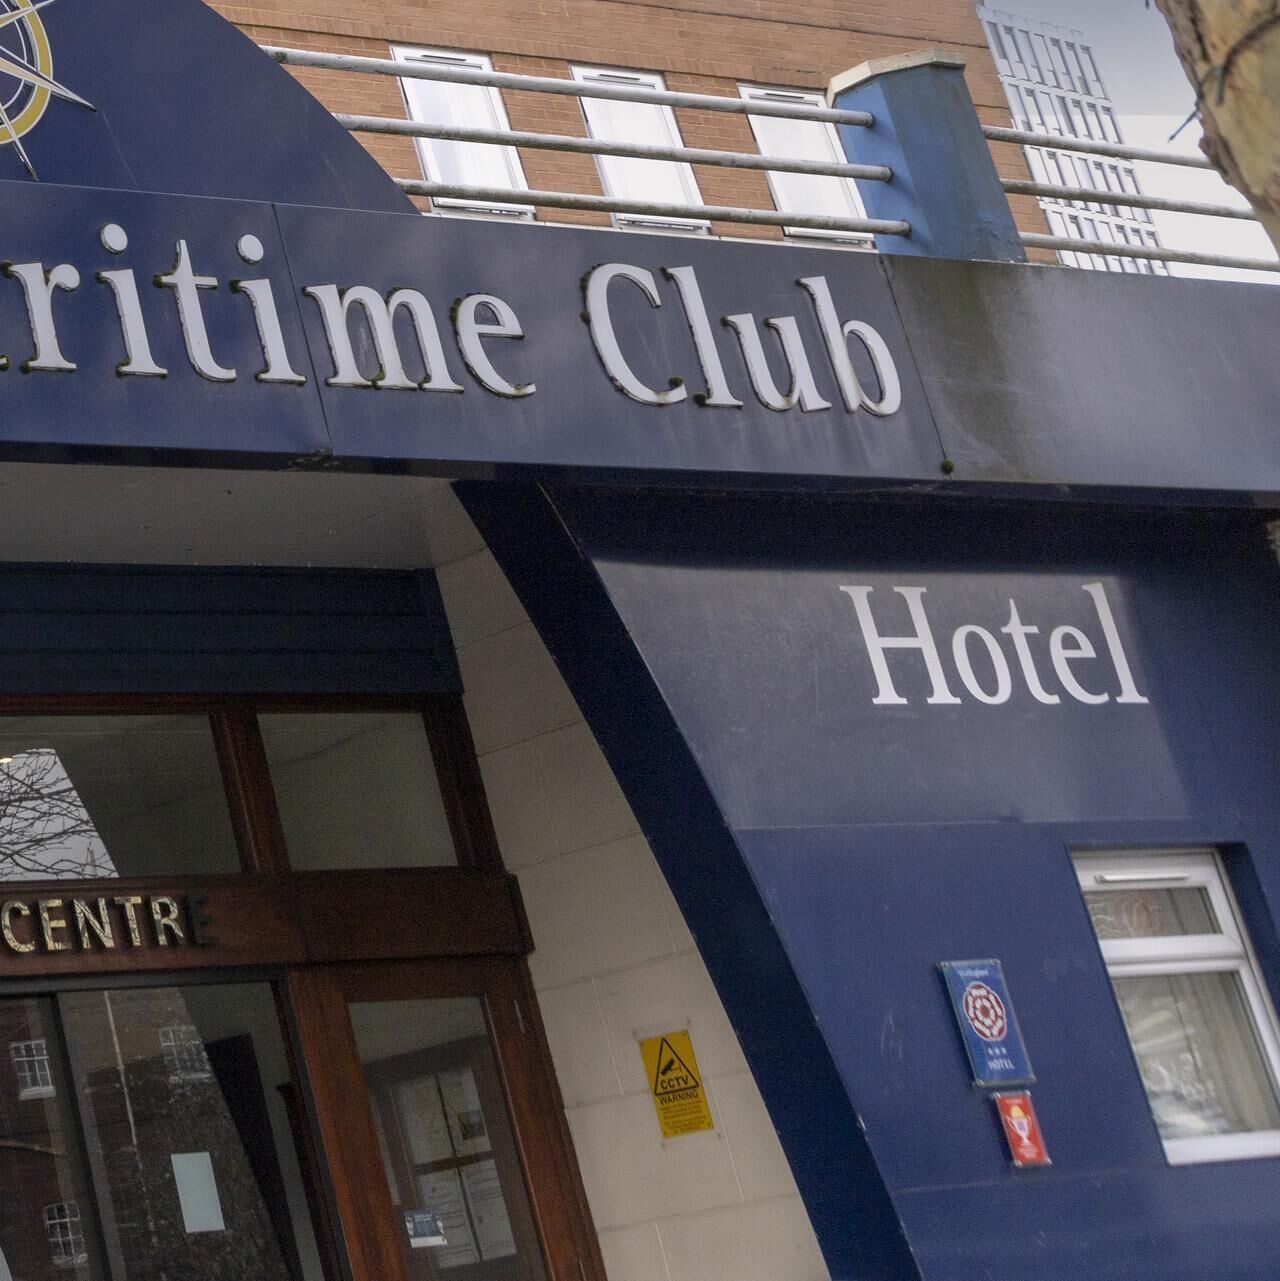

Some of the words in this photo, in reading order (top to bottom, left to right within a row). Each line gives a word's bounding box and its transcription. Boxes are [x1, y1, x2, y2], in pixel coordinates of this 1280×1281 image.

[581, 262, 903, 418] Club
[839, 581, 1150, 706] Hotel
[0, 894, 218, 954] CENTRE
[660, 1075, 689, 1090] CCTV
[988, 1058, 1014, 1071] HOTEL
[659, 1089, 699, 1105] WARNING
